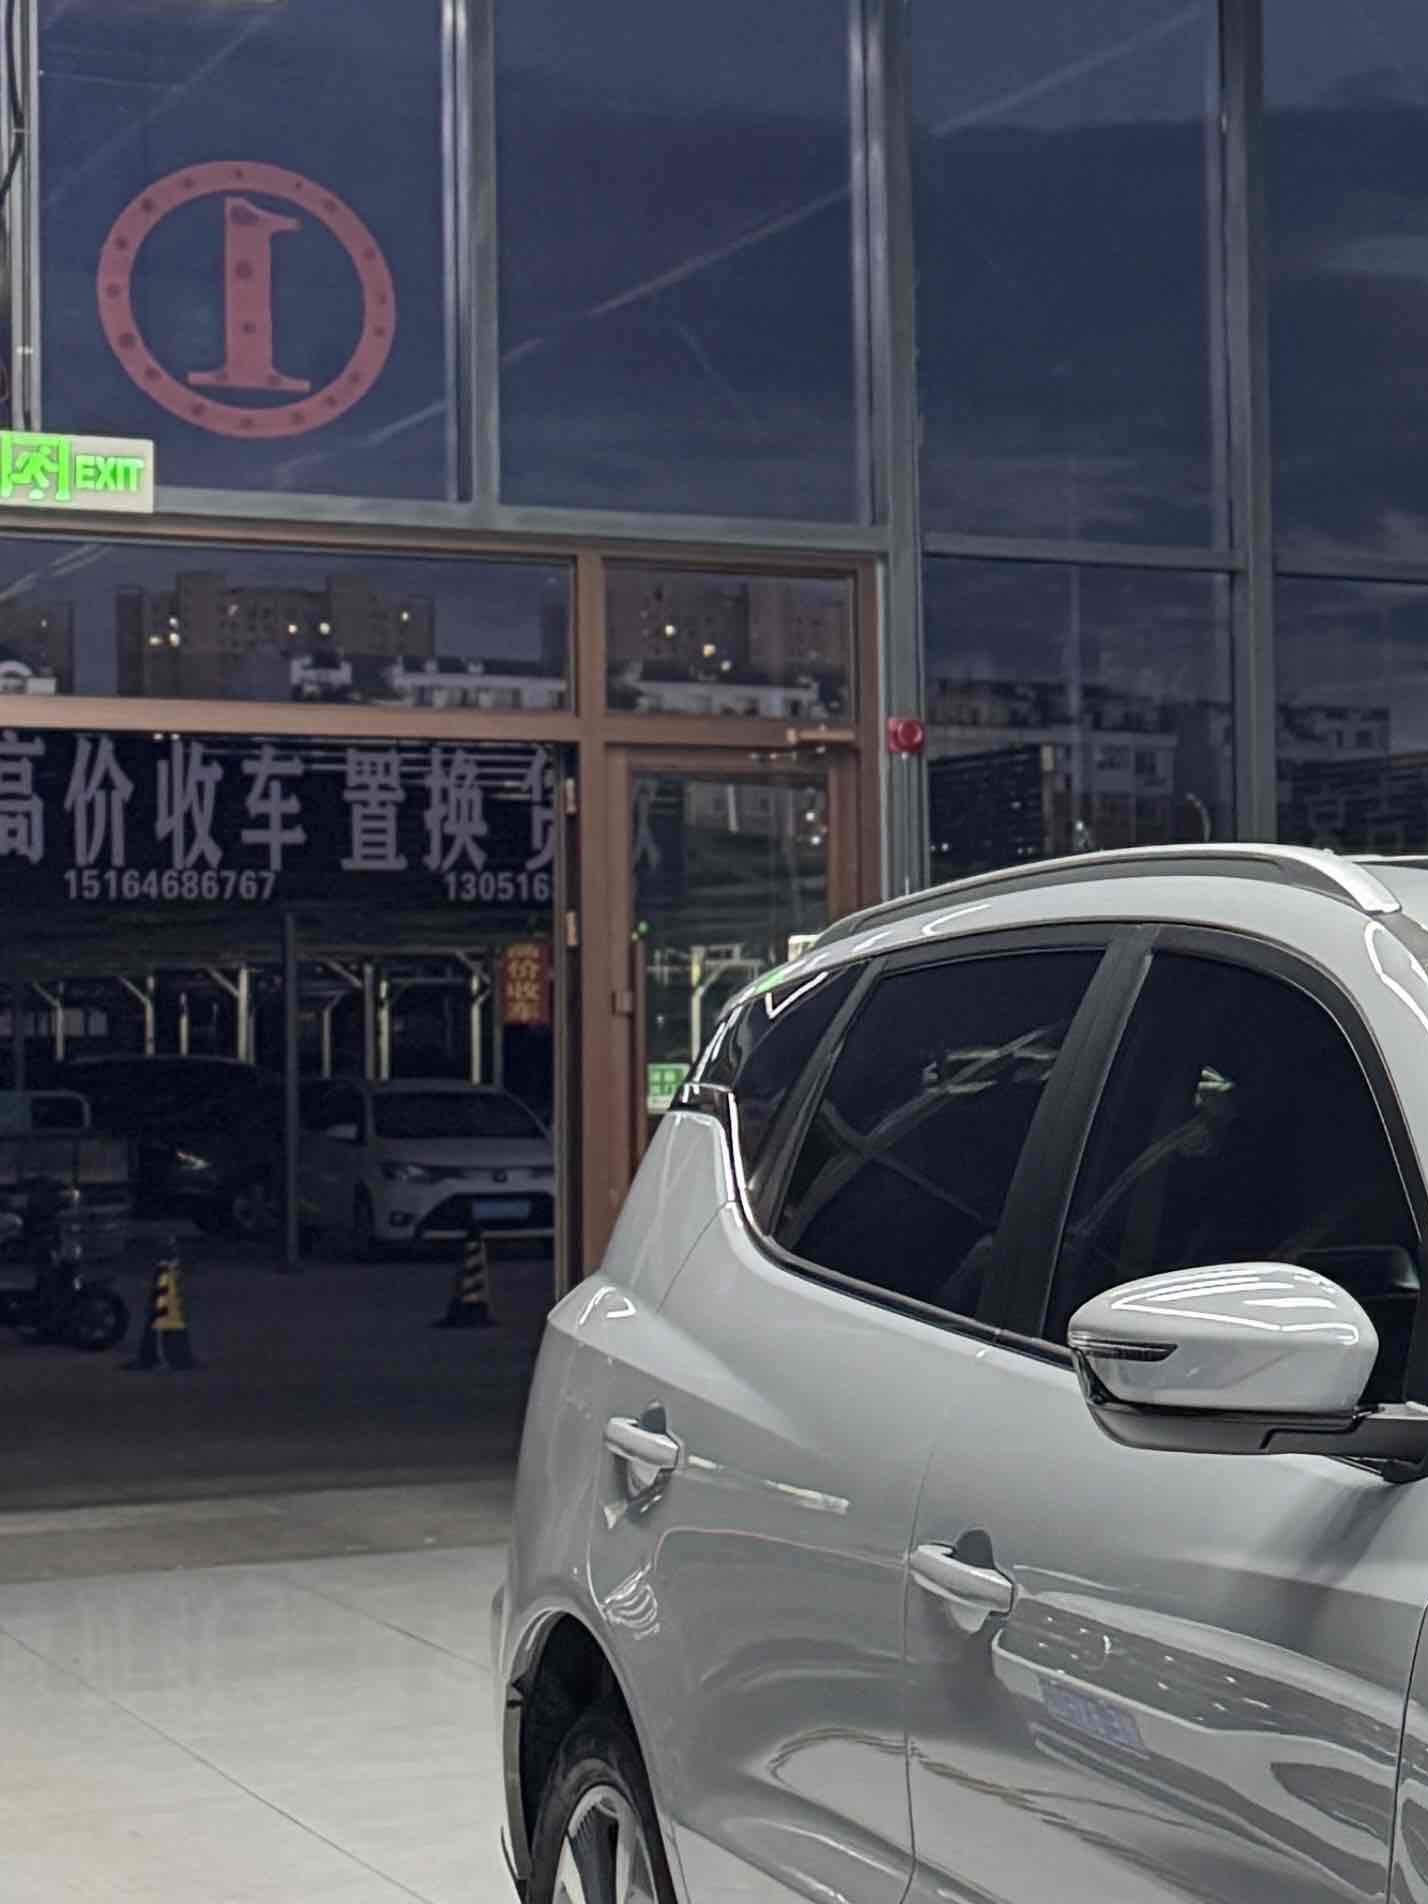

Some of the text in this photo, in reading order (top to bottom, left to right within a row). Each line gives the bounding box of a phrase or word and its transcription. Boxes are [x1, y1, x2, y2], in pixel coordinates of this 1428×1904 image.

[75, 455, 144, 493] EXIT
[0, 731, 307, 872] 高价收车
[64, 868, 277, 900] 15164686767
